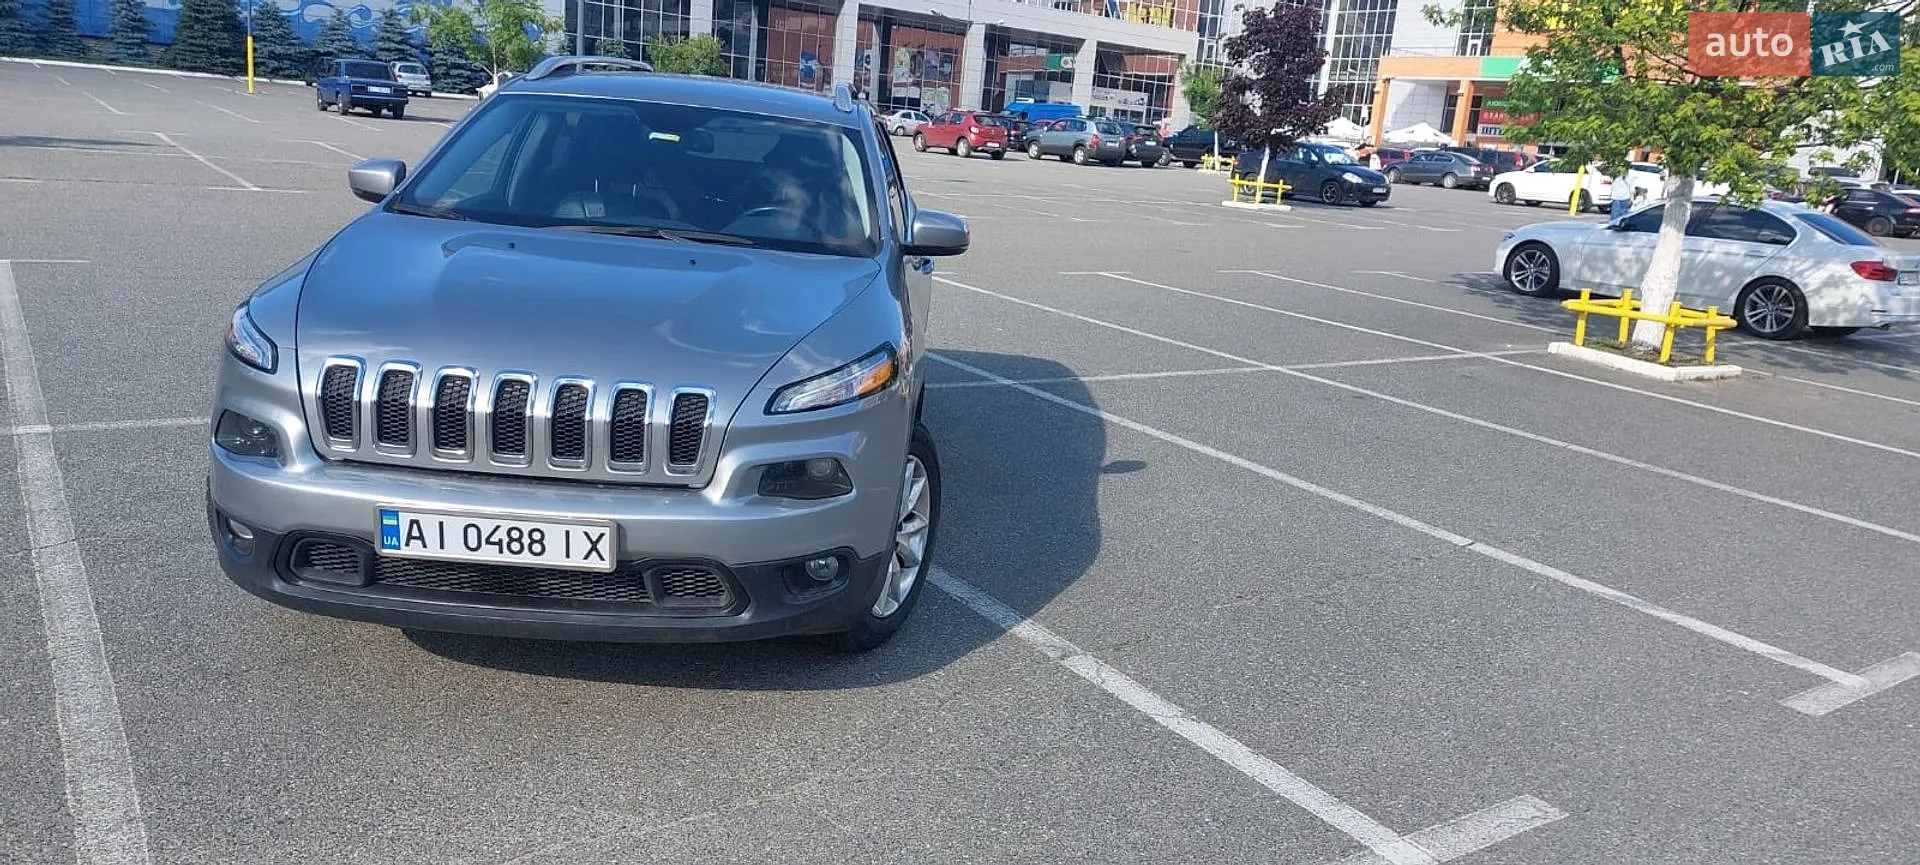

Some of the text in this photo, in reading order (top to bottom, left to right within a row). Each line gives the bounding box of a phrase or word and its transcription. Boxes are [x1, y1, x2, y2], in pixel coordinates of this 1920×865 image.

[383, 535, 400, 546] UA
[404, 518, 605, 562] AI 0488 IX
